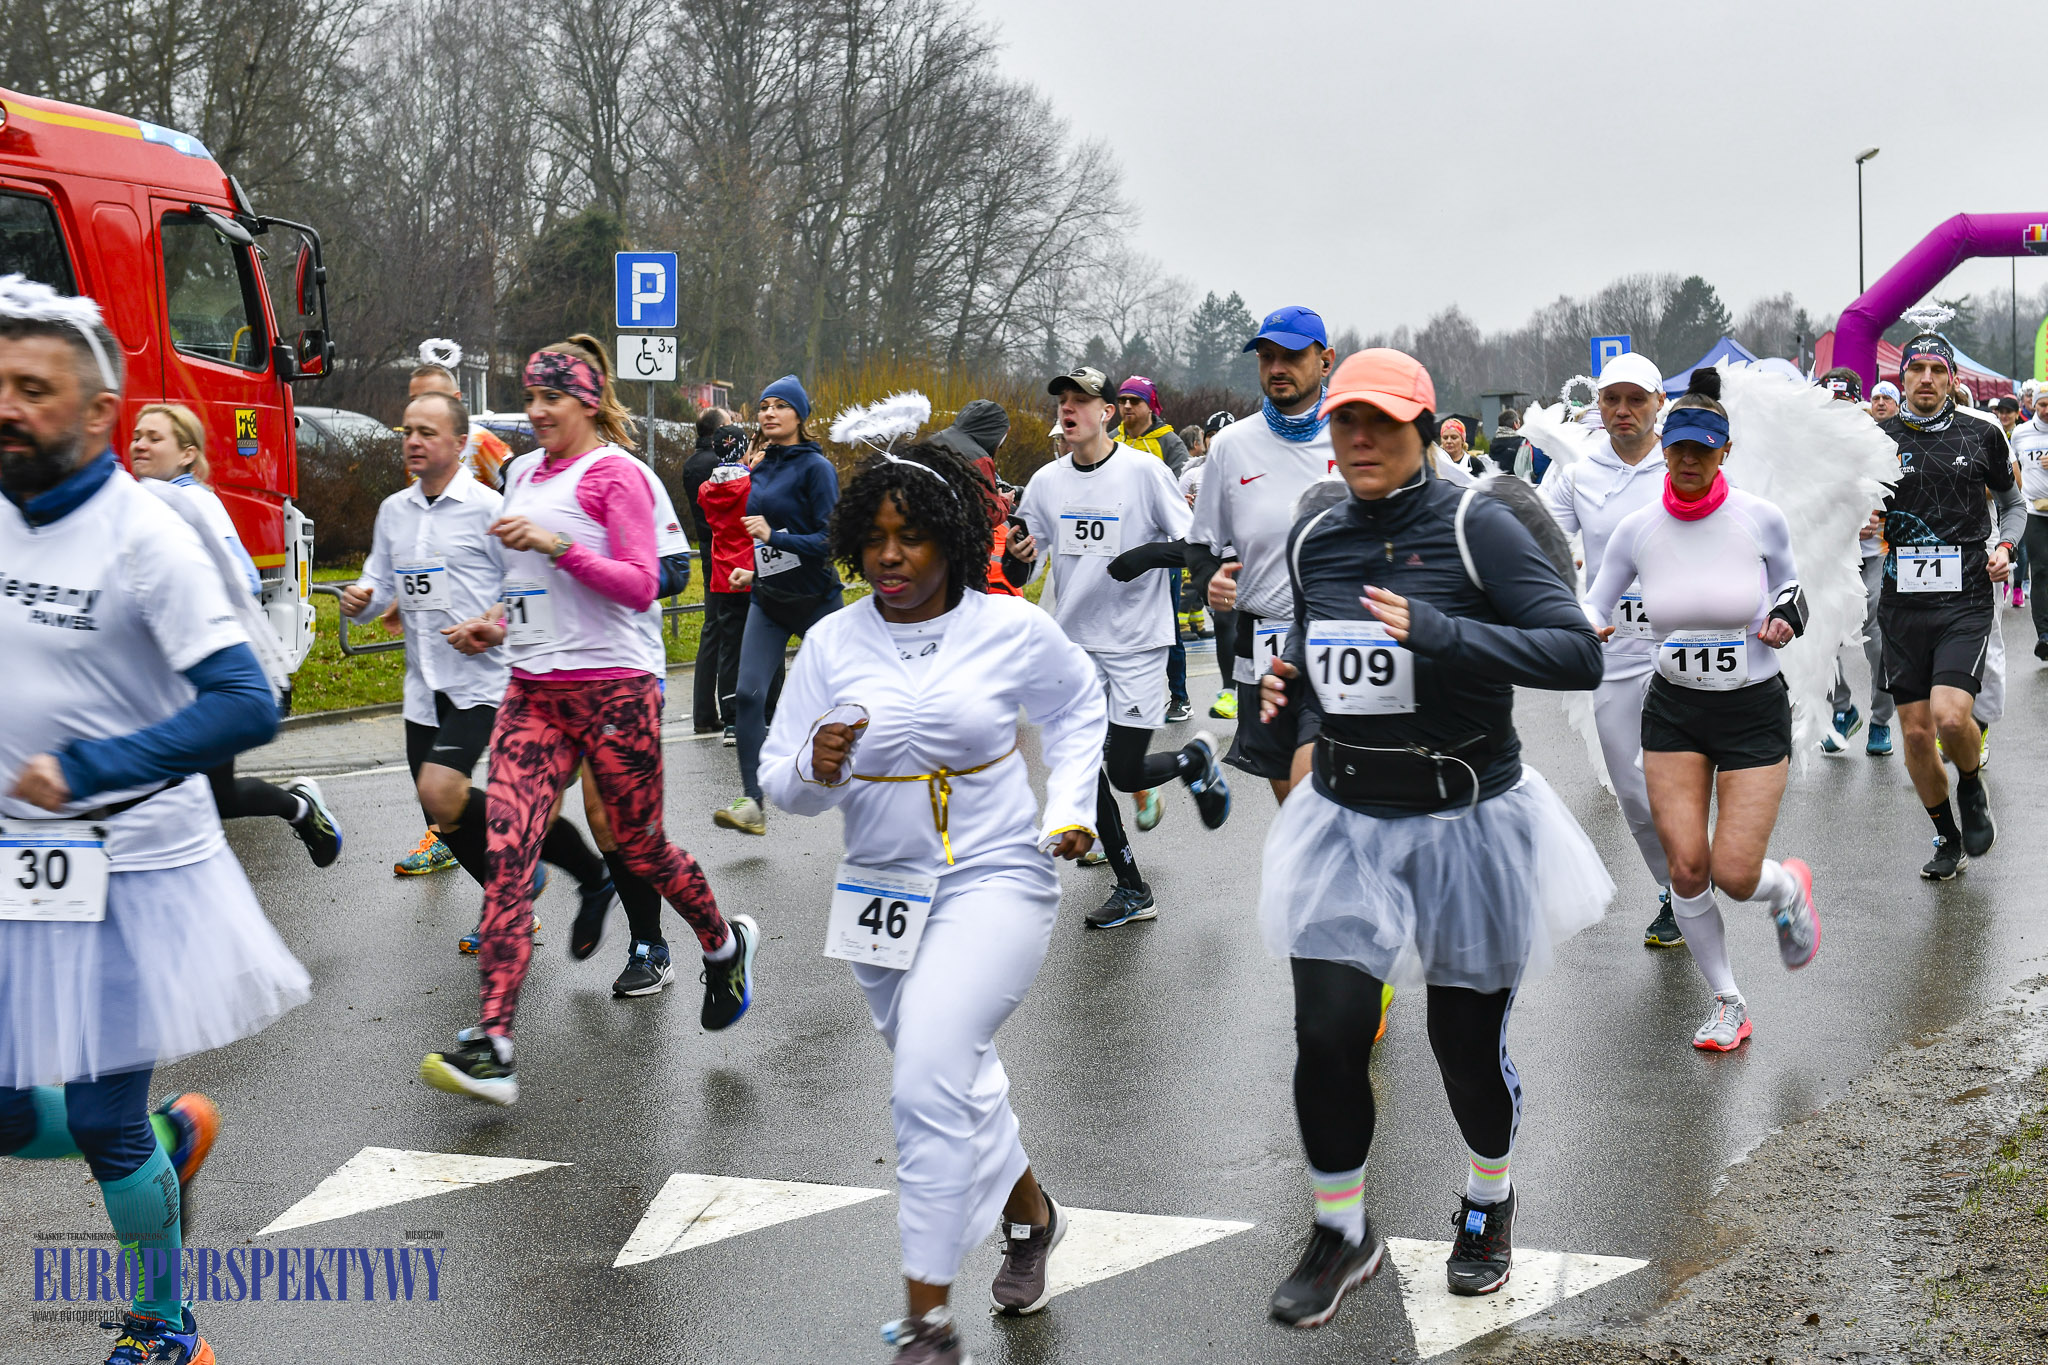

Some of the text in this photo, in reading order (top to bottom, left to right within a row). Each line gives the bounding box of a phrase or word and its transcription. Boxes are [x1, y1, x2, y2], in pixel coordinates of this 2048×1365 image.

[632, 262, 666, 321] P
[1600, 340, 1623, 371] P
[2027, 450, 2048, 462] 12
[1074, 520, 1105, 541] 50
[760, 545, 783, 564] 84
[1913, 558, 1942, 578] 71
[403, 573, 431, 596] 65
[1316, 646, 1396, 687] 109
[1671, 646, 1737, 672] 115
[15, 848, 71, 890] 30
[857, 897, 910, 939] 46
